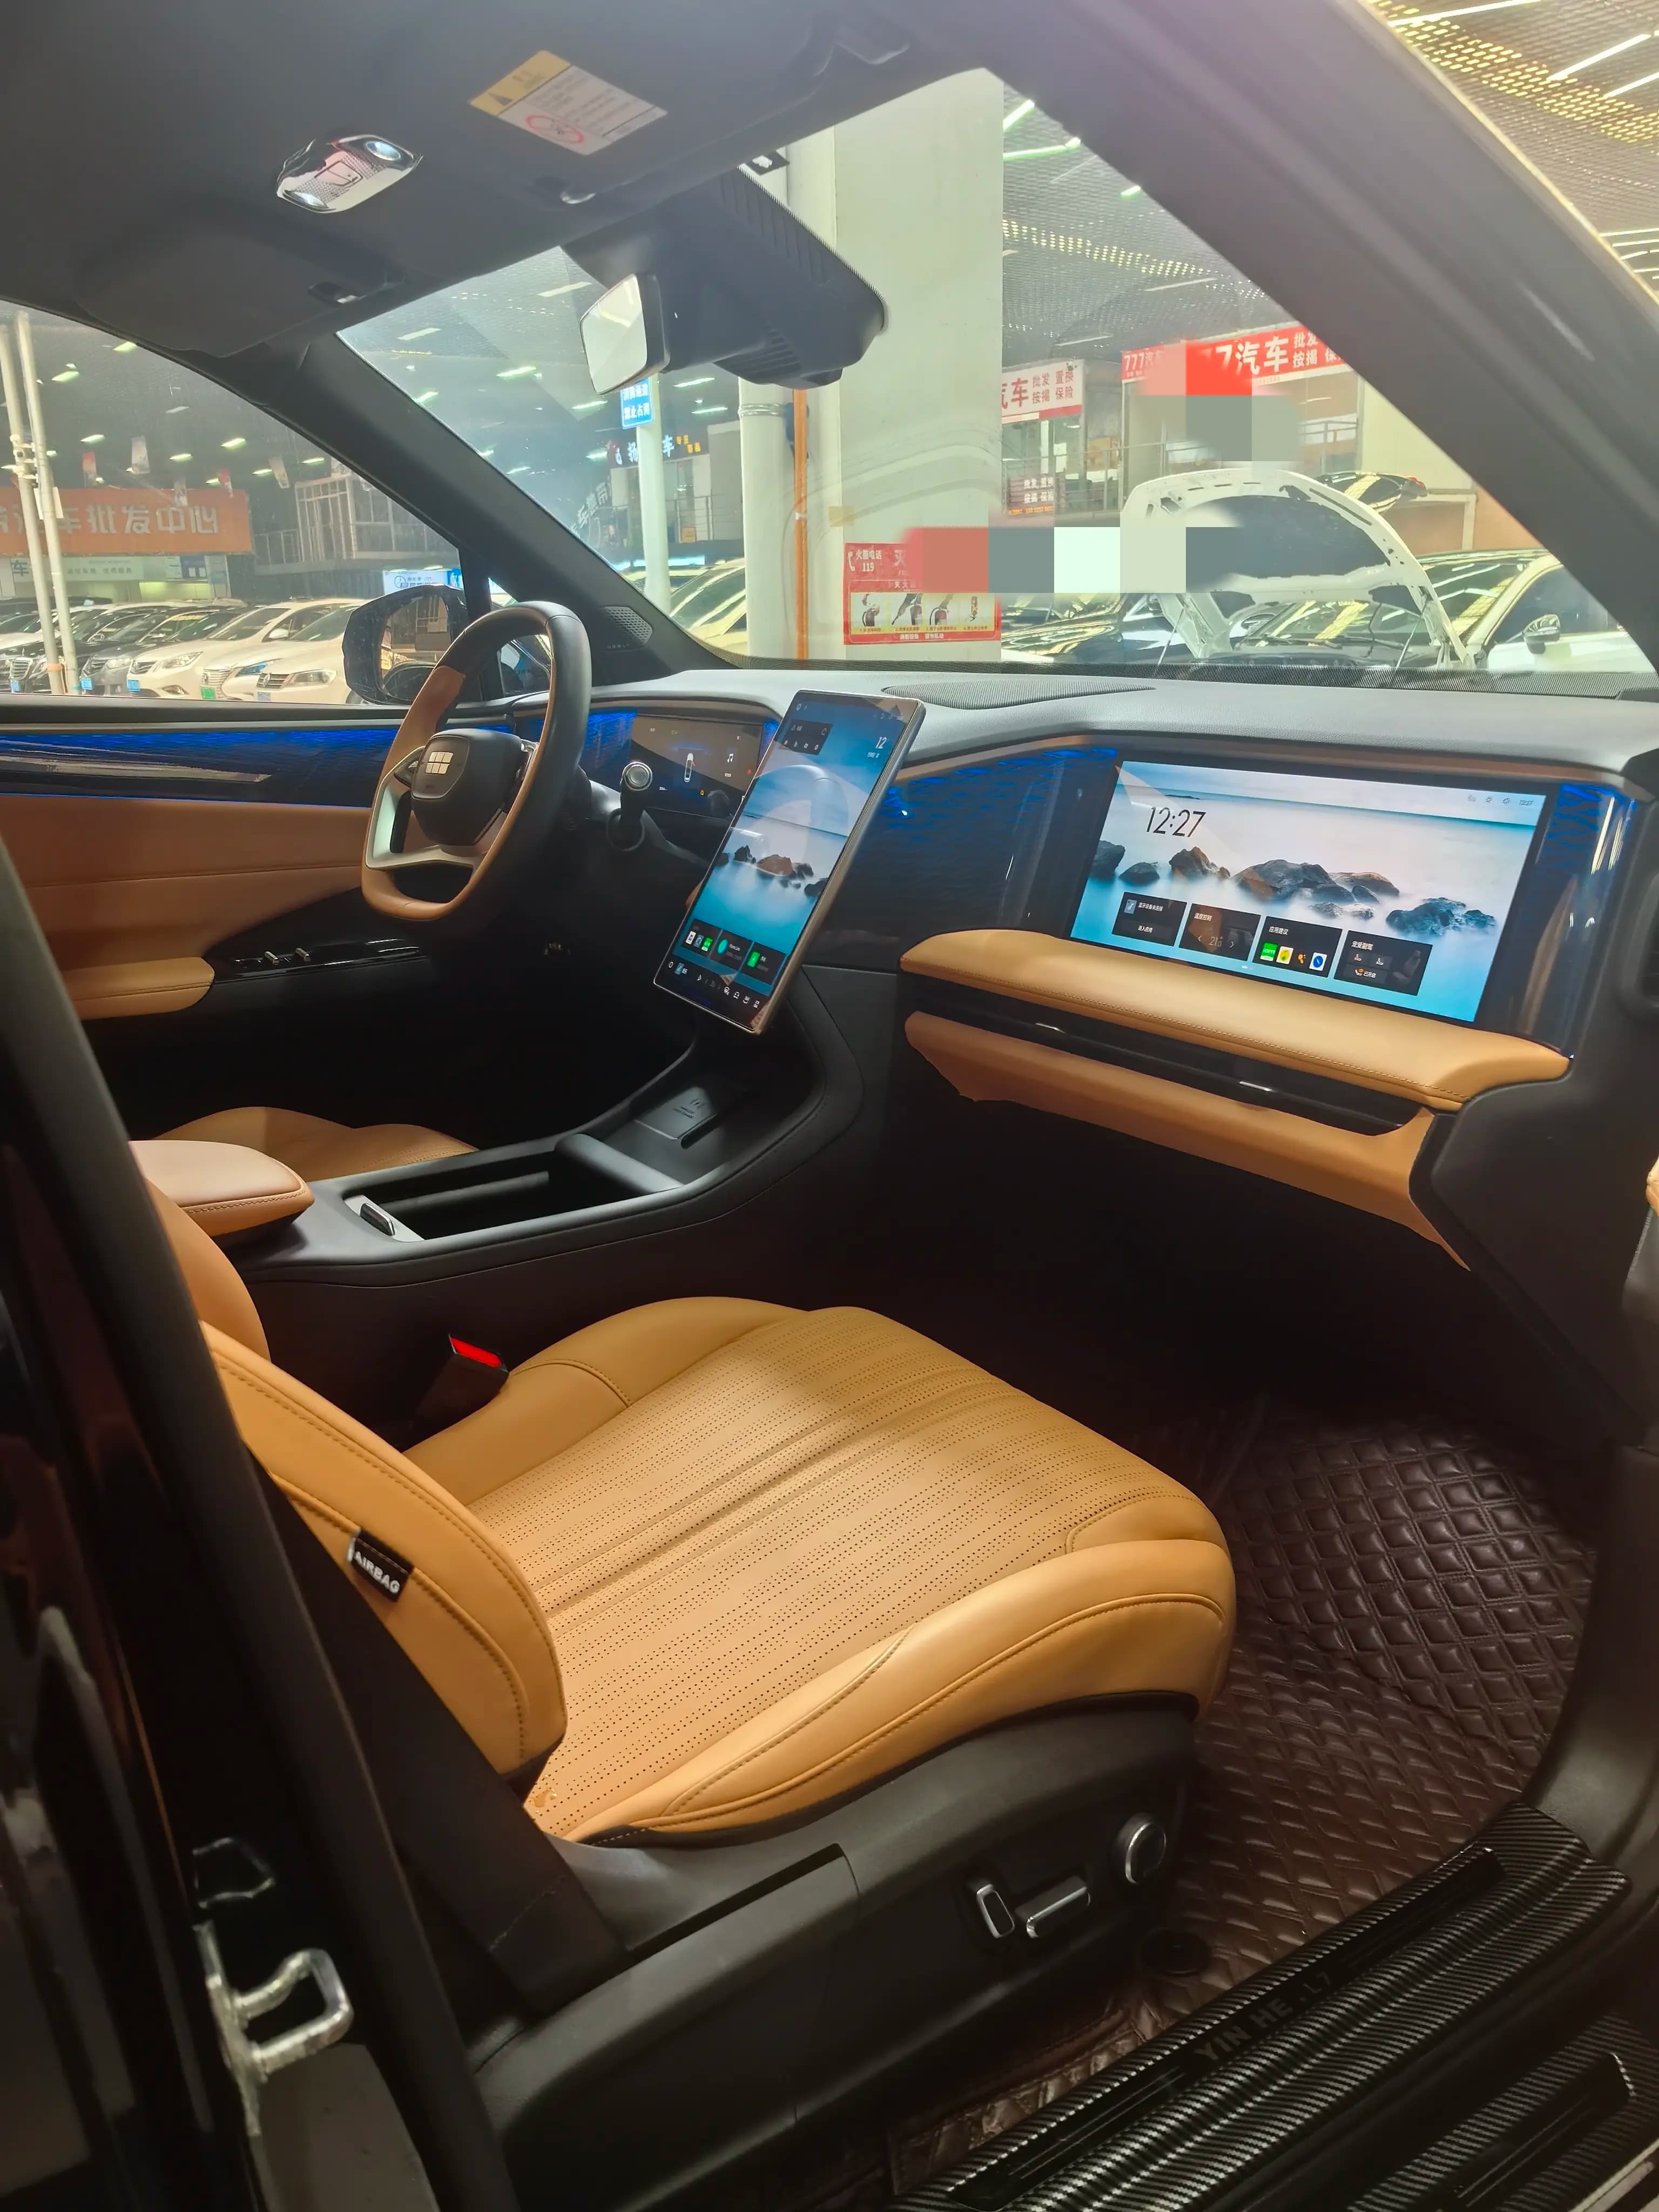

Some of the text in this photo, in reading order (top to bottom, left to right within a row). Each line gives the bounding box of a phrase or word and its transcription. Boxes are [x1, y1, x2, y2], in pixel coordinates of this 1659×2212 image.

[1325, 348, 1341, 362] 保
[862, 563, 874, 572] 119
[1147, 806, 1206, 837] 12:27
[354, 1551, 400, 1594] AIRBAG
[1193, 2026, 1252, 2061] YIN
